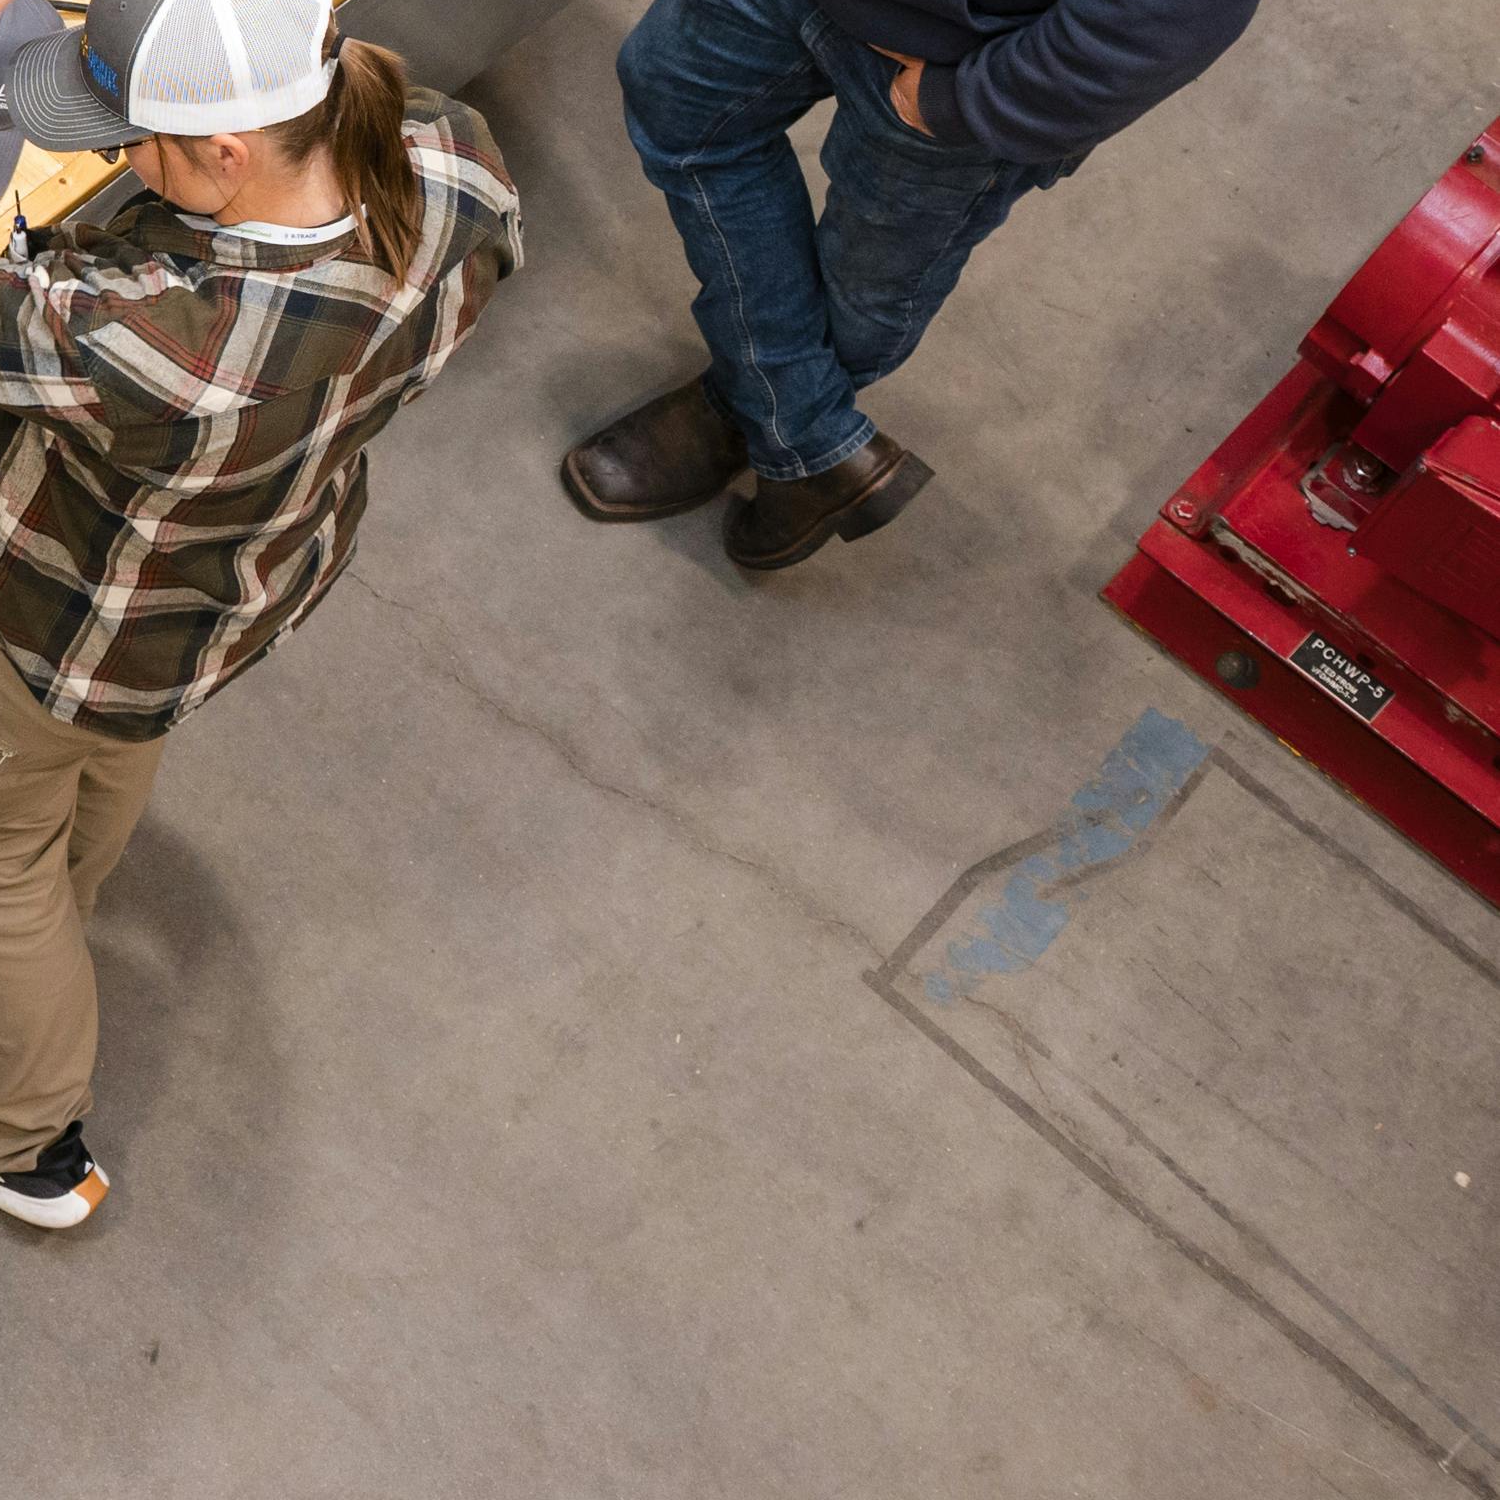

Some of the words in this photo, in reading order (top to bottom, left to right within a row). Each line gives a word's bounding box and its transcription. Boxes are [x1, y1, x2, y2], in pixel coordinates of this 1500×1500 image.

[1310, 637, 1386, 697] PCHWP-5
[1319, 662, 1336, 678] FED
[1334, 674, 1358, 695] FROM
